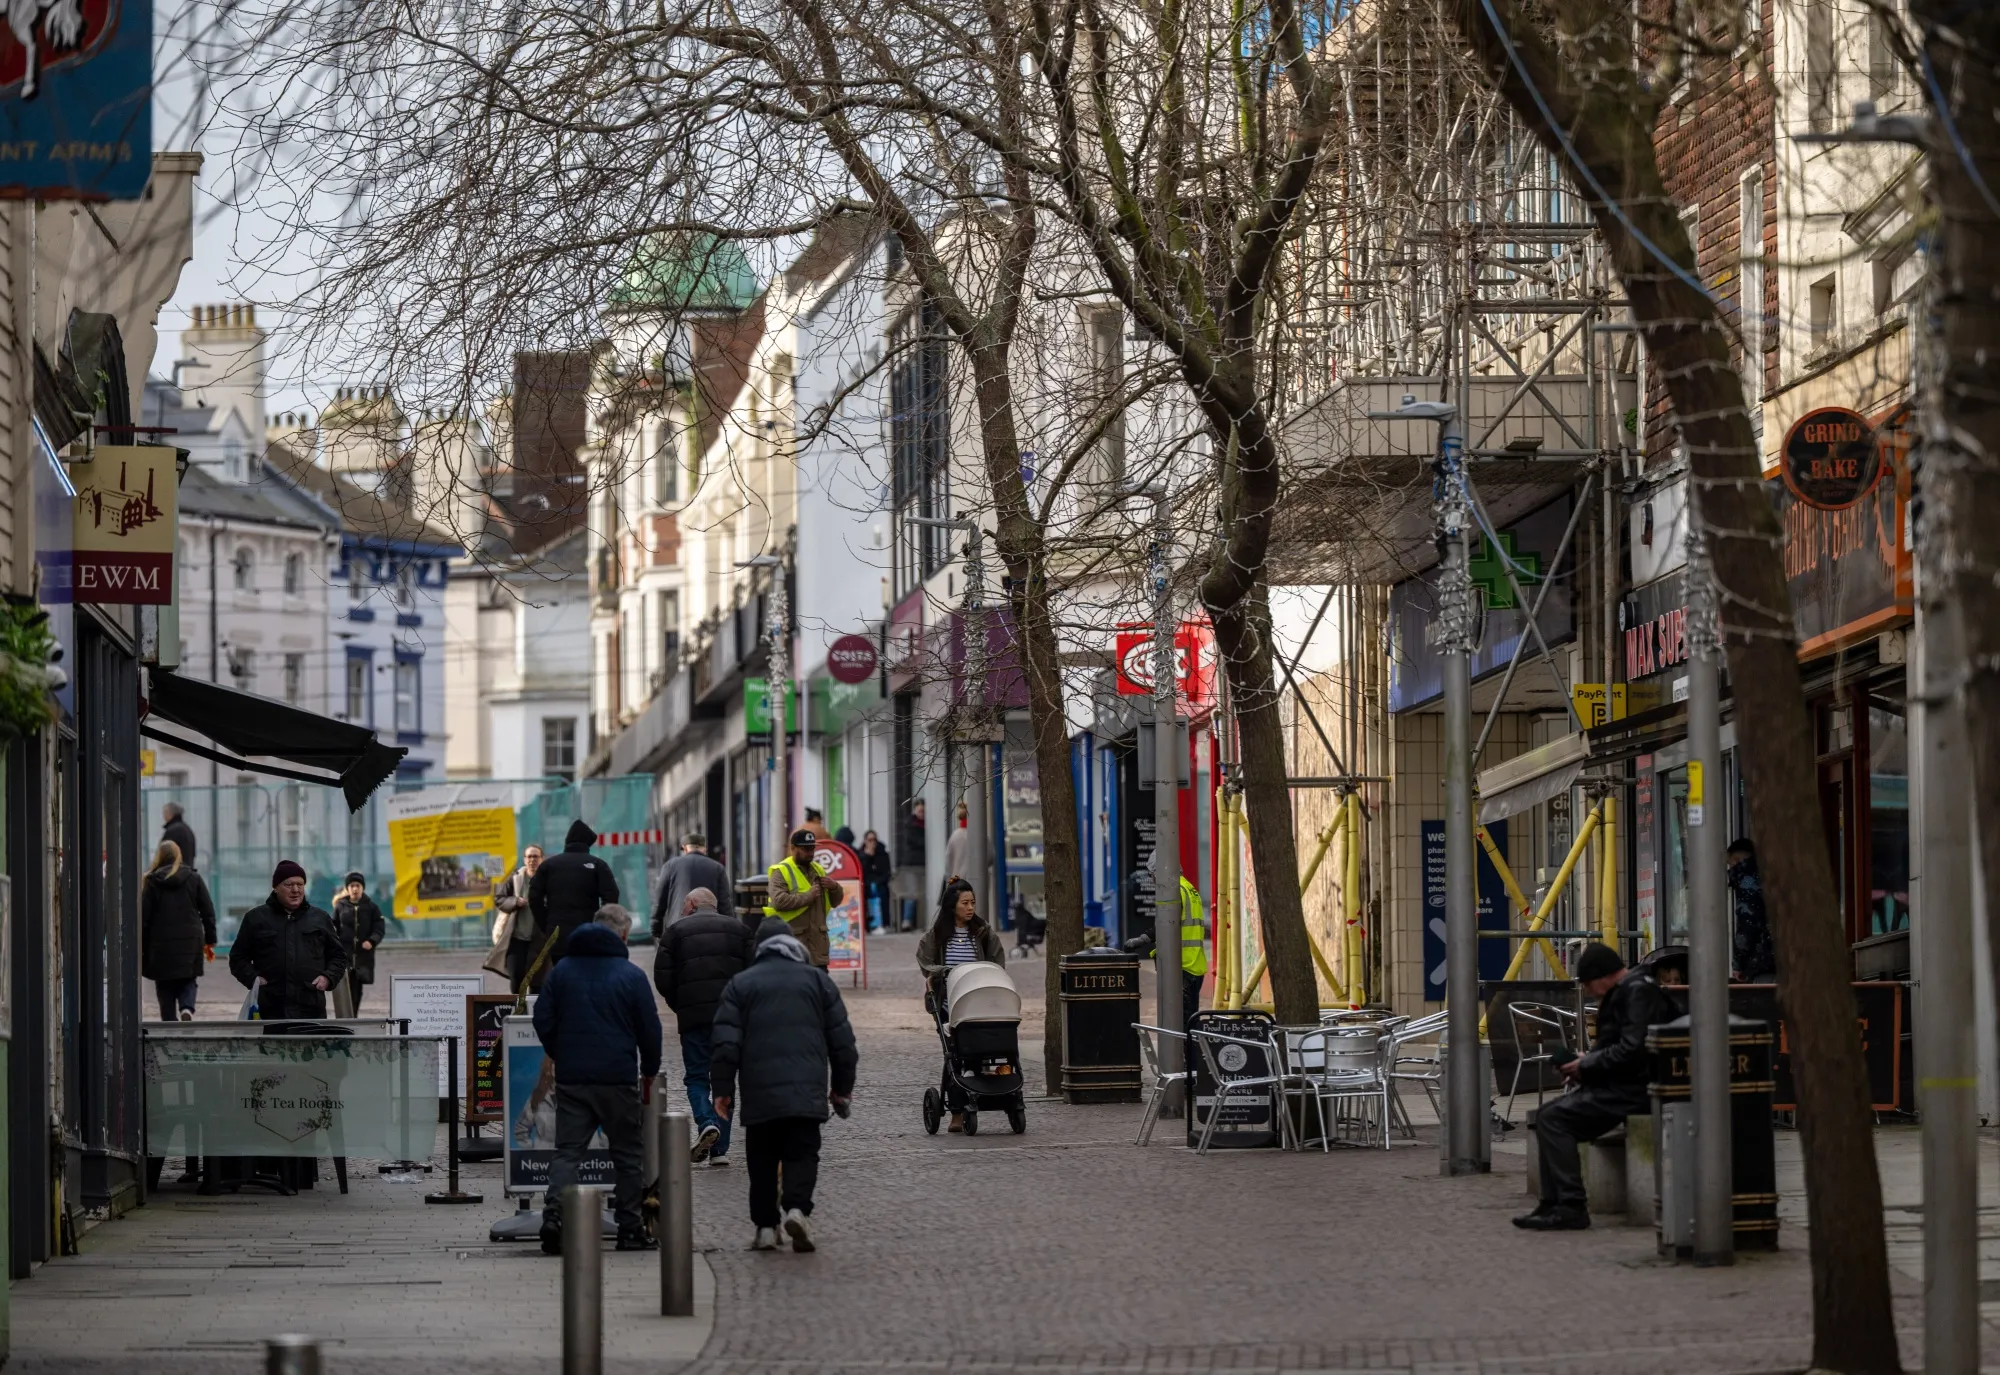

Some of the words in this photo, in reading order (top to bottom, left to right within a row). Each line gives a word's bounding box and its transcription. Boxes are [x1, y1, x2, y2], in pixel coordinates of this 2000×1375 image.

[1804, 423, 1860, 443] GRIND
[1811, 459, 1857, 478] BAKE
[79, 564, 160, 590] EWM
[1625, 620, 1655, 681] MAX
[1428, 876, 1446, 884] baby
[410, 984, 439, 992] Jewellery
[441, 984, 465, 992] Repairs
[1074, 975, 1125, 988] LITTER
[439, 1008, 459, 1016] Straps
[1203, 1021, 1221, 1031] Proud
[1232, 1023, 1241, 1031] Be
[1241, 1023, 1263, 1037] Serving
[240, 1097, 267, 1109] The
[270, 1097, 295, 1109] Tea
[299, 1097, 345, 1109] Rooms
[521, 1159, 549, 1170] New
